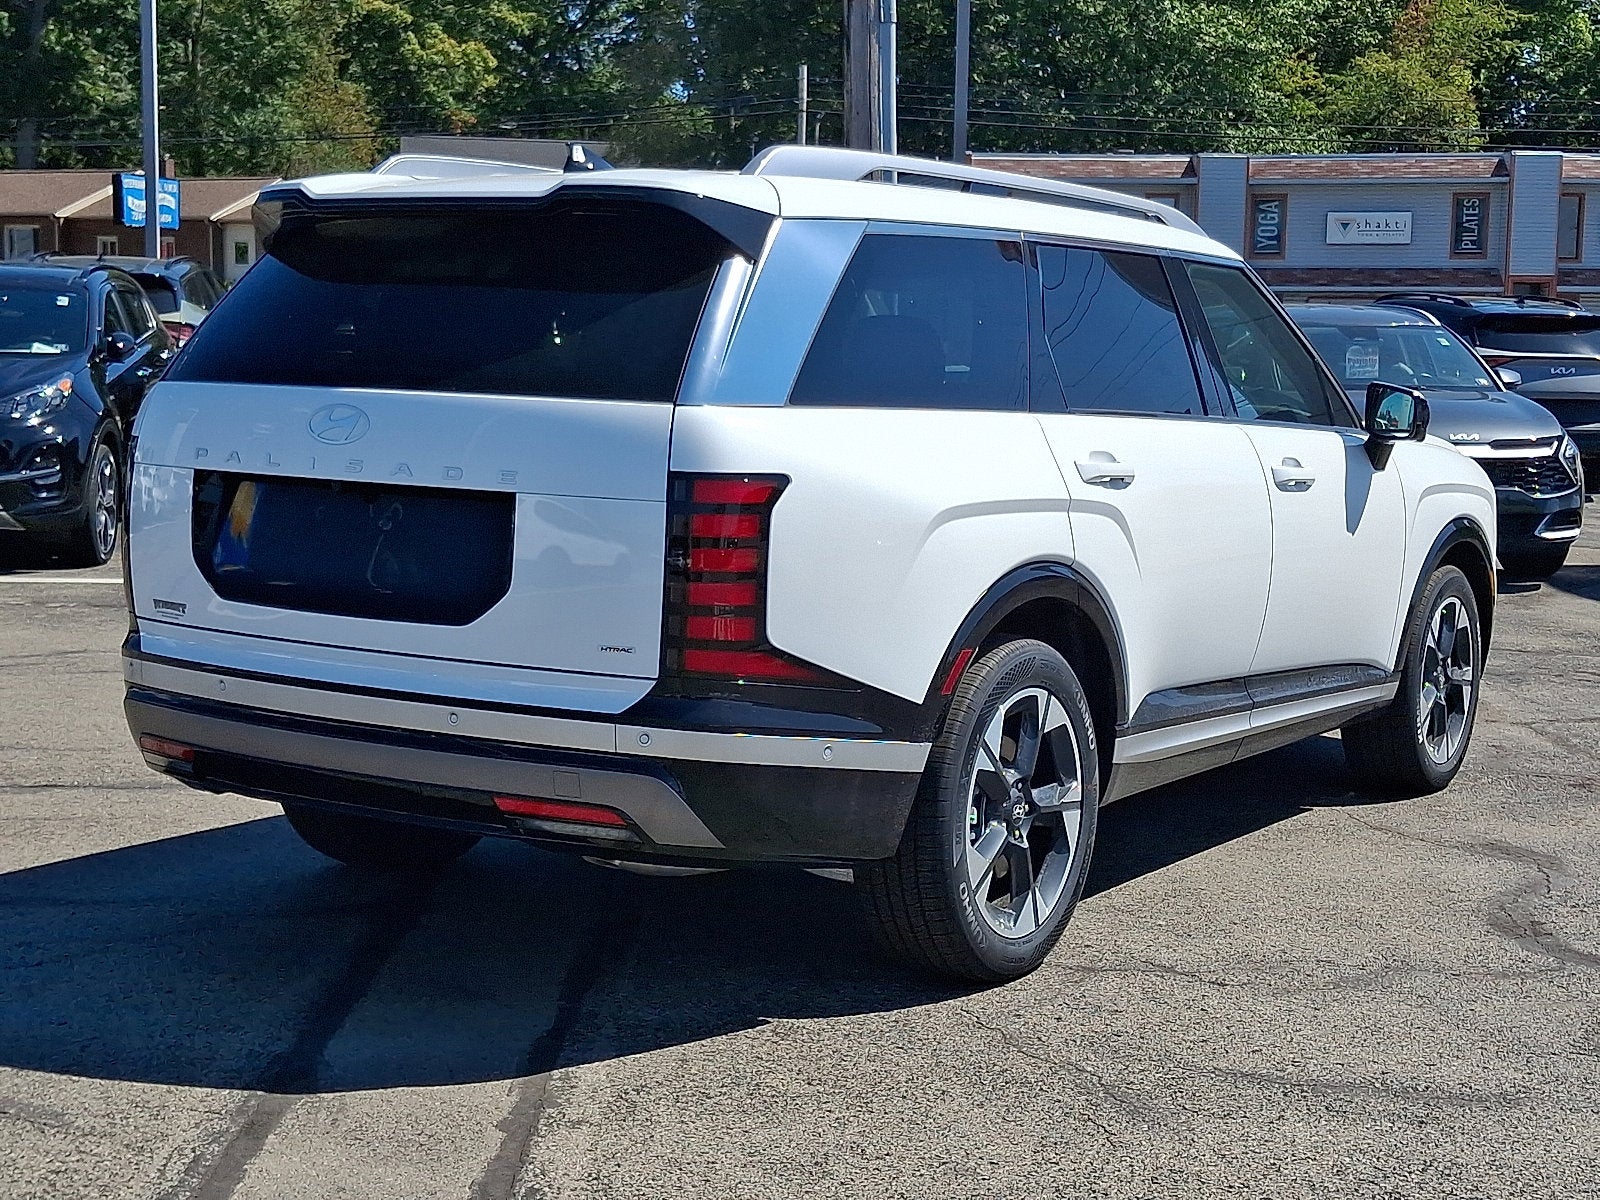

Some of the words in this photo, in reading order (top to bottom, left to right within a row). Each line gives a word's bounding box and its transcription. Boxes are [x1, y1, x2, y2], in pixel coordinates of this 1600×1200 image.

[1257, 201, 1279, 248] YOGA
[1356, 218, 1407, 229] shakti
[1462, 199, 1479, 249] PILATES
[194, 447, 518, 485] PALISADE
[600, 646, 633, 654] HTRAC
